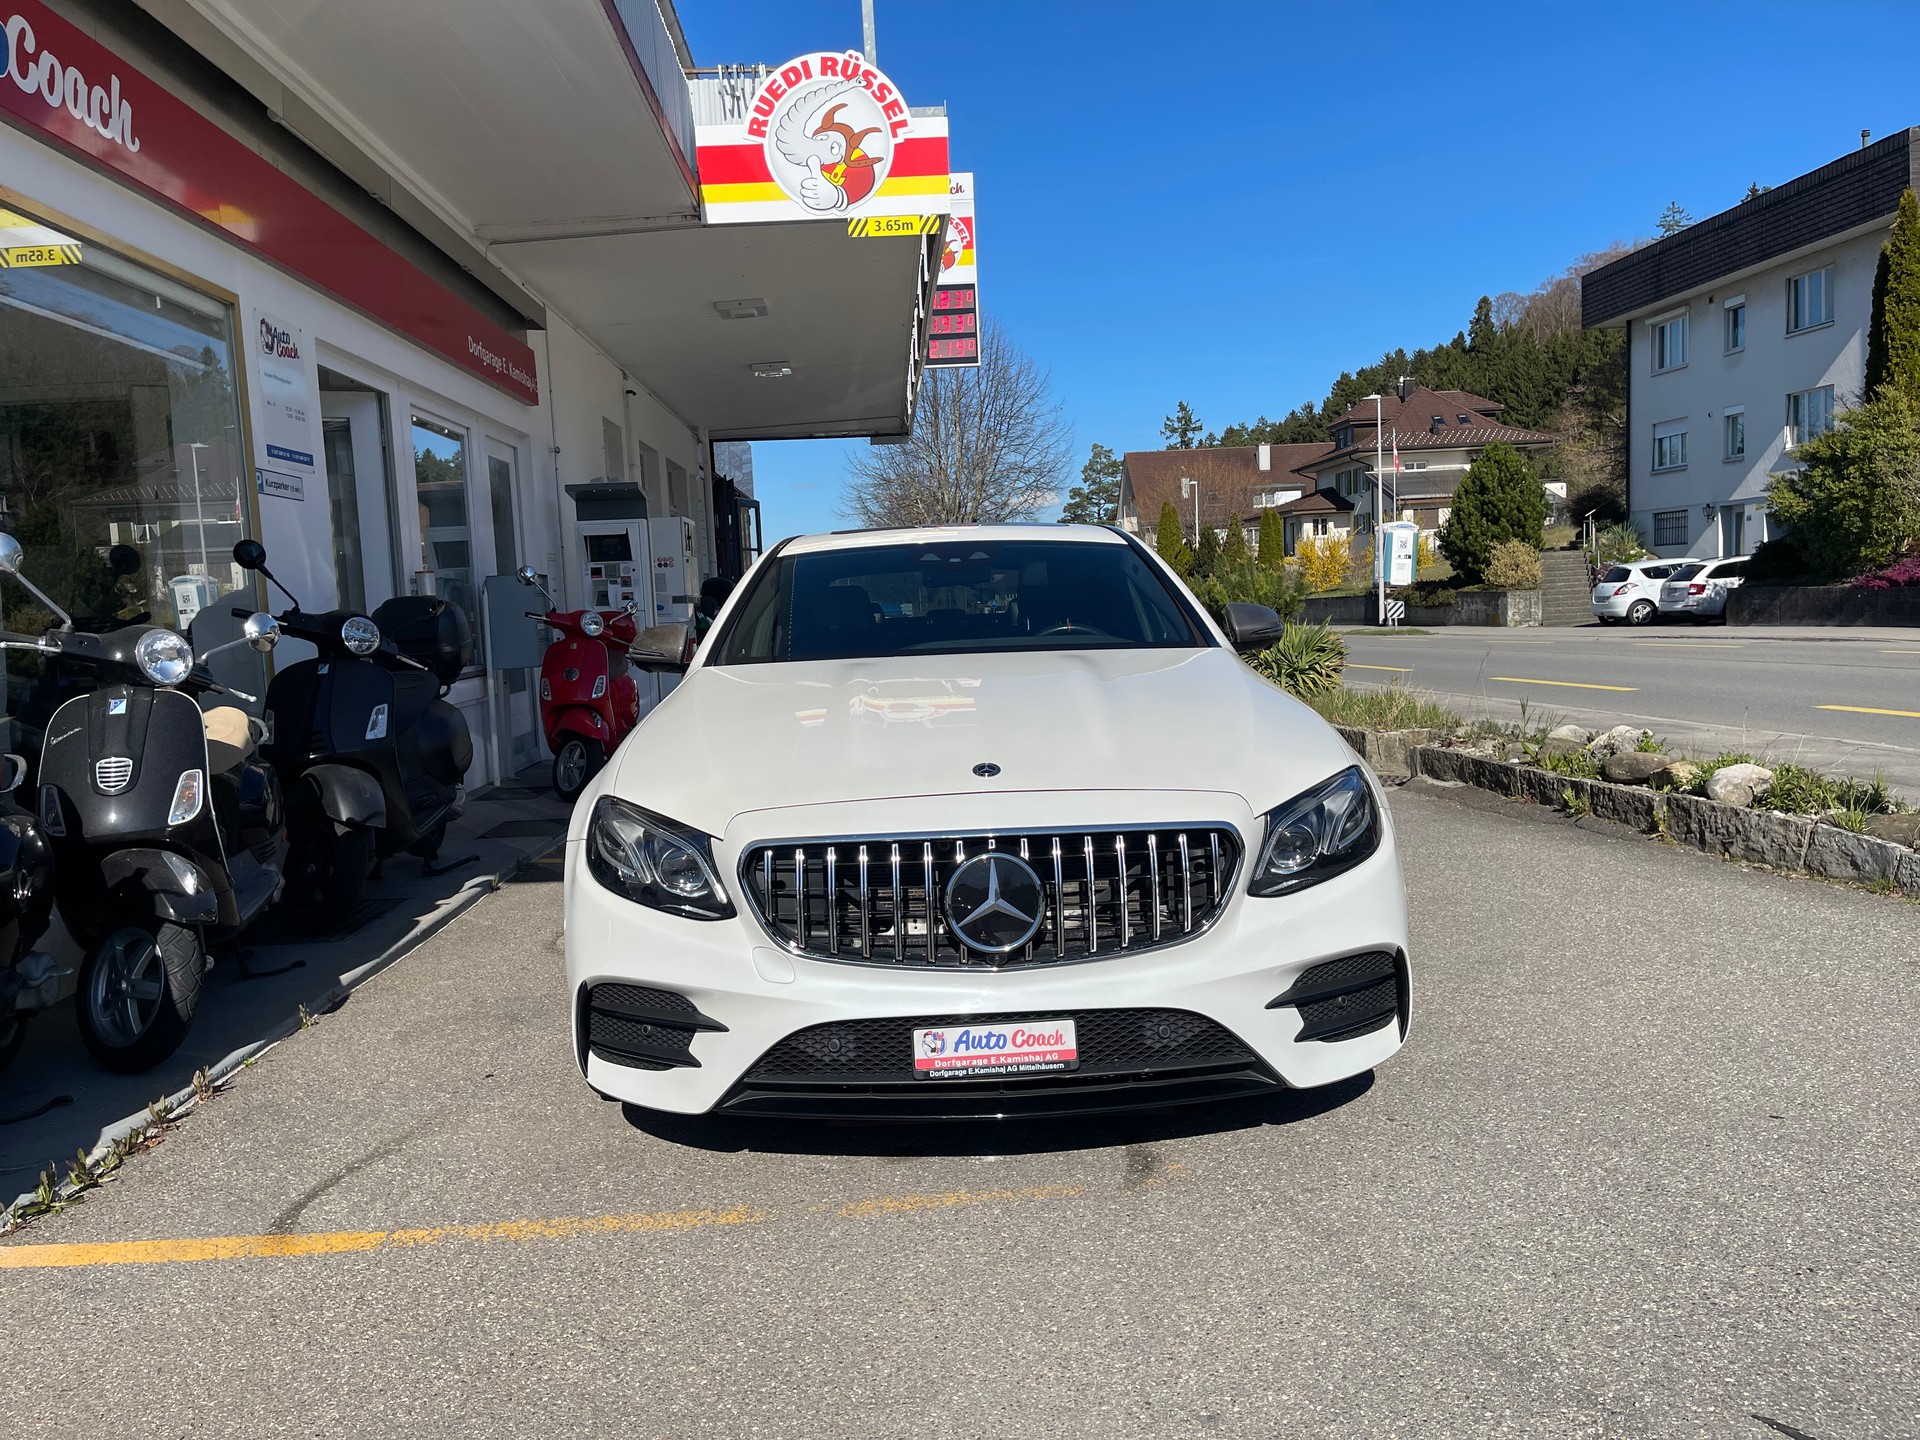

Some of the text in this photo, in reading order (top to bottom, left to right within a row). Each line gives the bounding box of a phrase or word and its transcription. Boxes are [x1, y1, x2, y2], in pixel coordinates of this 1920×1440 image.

[6, 14, 140, 152] Coach
[747, 53, 909, 139] RUEDI RÜSSEL
[874, 220, 914, 232] 3.65m
[948, 217, 969, 244] SSEL
[272, 327, 291, 345] Auto
[276, 342, 300, 360] Coach
[467, 335, 503, 373] Dorfgarage
[502, 357, 509, 374] E.
[953, 1029, 1066, 1053] Auto Coach
[929, 1068, 967, 1078] Dorfgarage
[1007, 1065, 1018, 1073] AG
[1019, 1062, 1065, 1072] Mittelhäusern
[935, 1057, 989, 1068] Dorfgarage
[1045, 1052, 1059, 1061] AG
